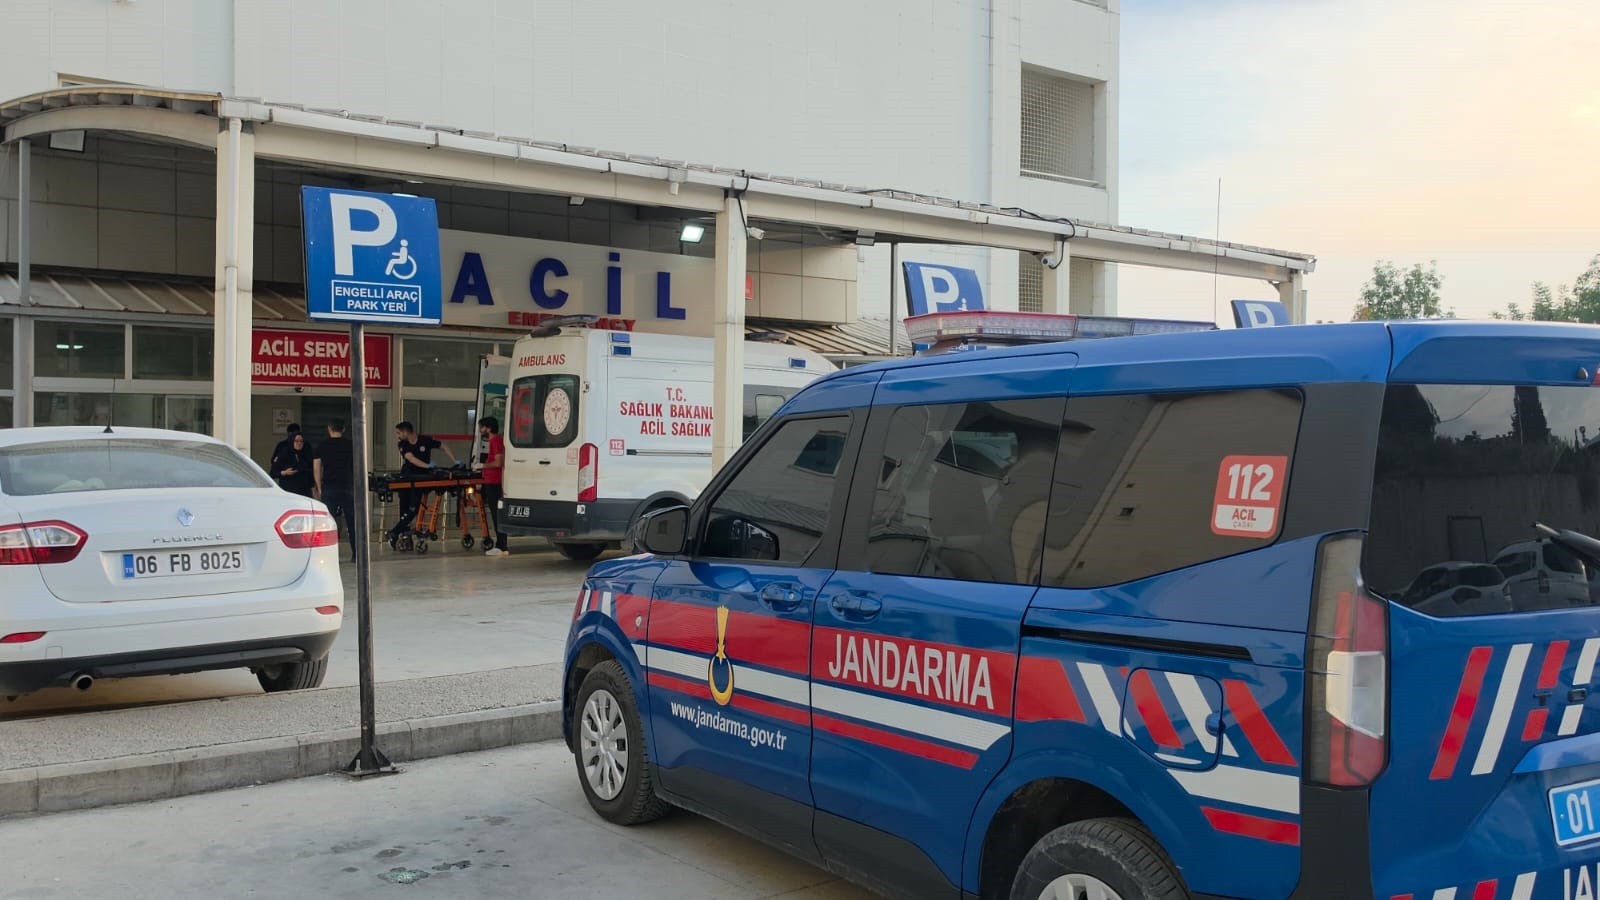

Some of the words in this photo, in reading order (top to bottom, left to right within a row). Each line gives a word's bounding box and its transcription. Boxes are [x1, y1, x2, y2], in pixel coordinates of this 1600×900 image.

[330, 193, 397, 276] P
[335, 286, 384, 299] ENGELLİ
[386, 290, 418, 304] ARAÇ
[449, 252, 686, 320] ACİL
[920, 266, 959, 314] P
[347, 299, 378, 311] PARK
[381, 301, 407, 312] YERİ
[258, 336, 300, 357] ACİL
[518, 353, 566, 368] AMBULANS
[313, 365, 346, 379] GELEN
[665, 387, 687, 402] T.C.
[620, 399, 663, 417] SAĞLIK
[640, 419, 666, 436] ACİL
[671, 419, 711, 437] SAĞLIK
[1228, 463, 1274, 500] 112
[152, 534, 224, 544] FLUENCE
[136, 556, 158, 574] 06
[170, 553, 191, 572] FB
[201, 551, 241, 570] 8025
[828, 633, 994, 710] JANDARMA
[671, 701, 787, 750] www.jandarma.gov.tr
[1566, 790, 1594, 834] 01
